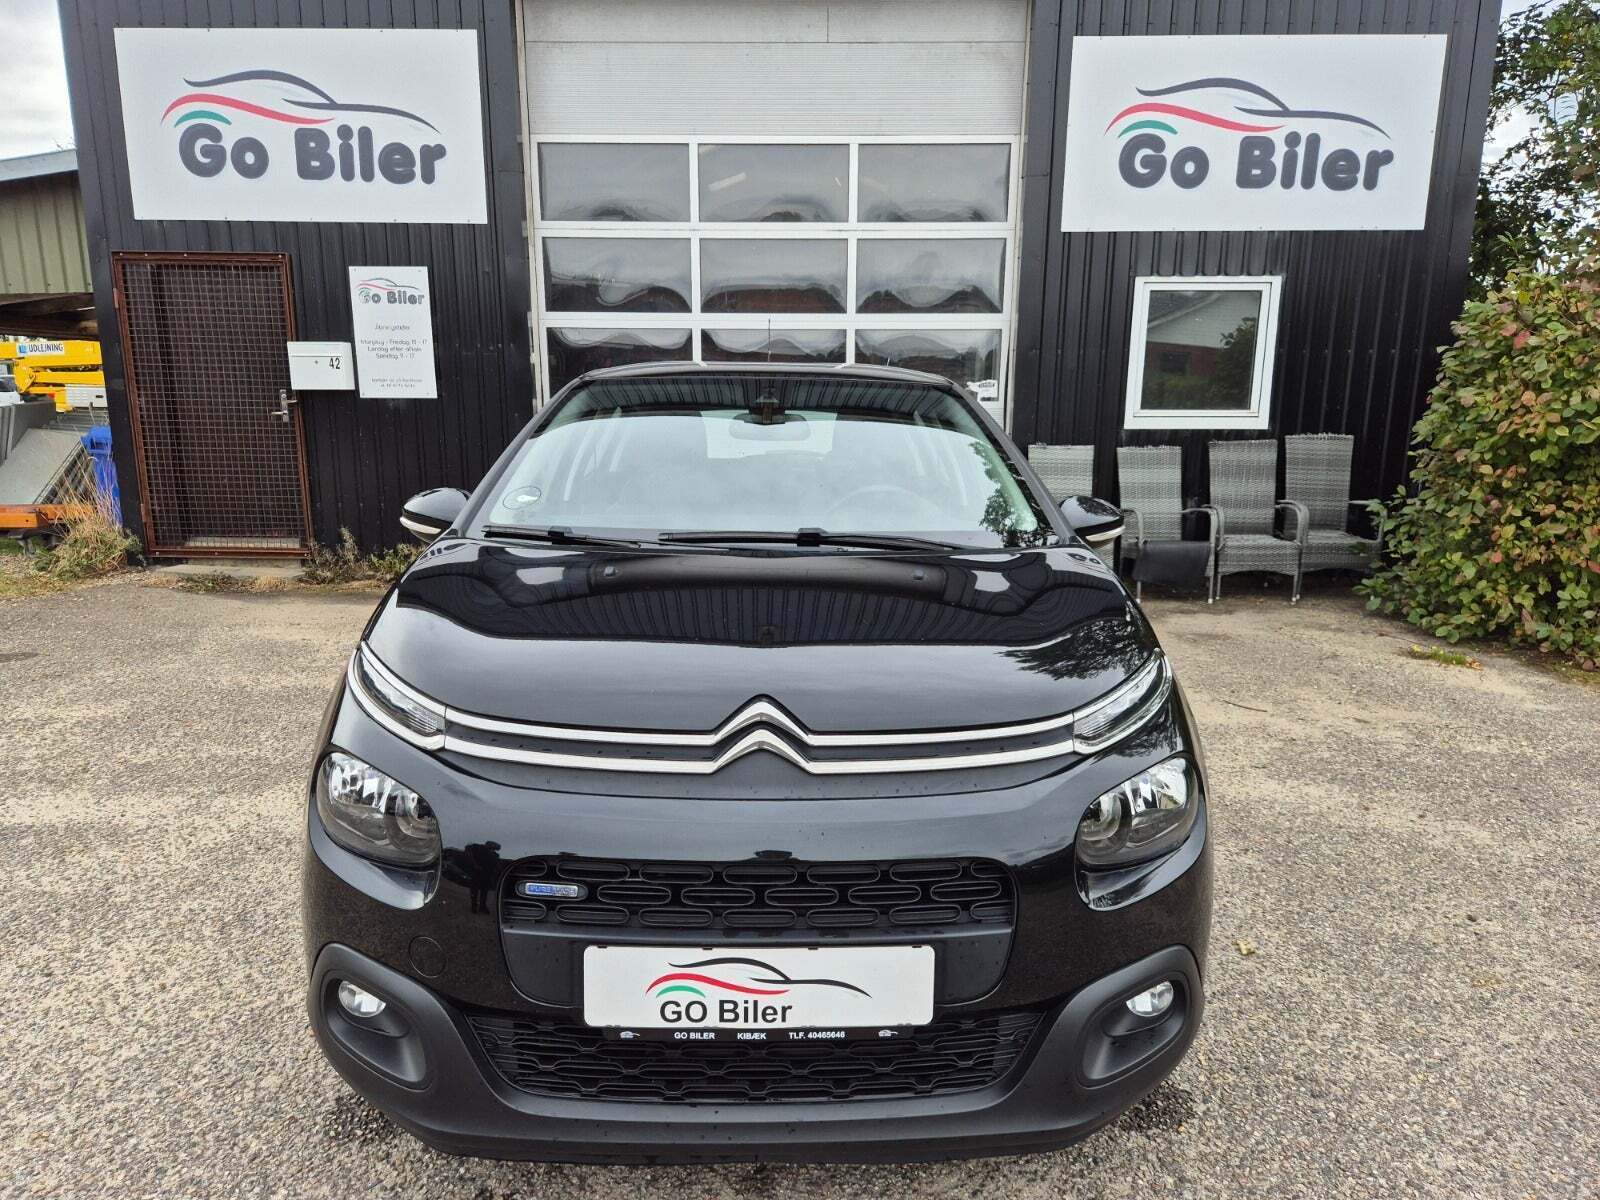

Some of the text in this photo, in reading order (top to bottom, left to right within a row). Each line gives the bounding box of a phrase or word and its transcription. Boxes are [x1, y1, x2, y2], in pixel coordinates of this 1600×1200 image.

[179, 123, 446, 184] Go Biler
[1119, 131, 1394, 191] Go Biler
[387, 290, 425, 304] Biler
[28, 343, 64, 352] UDLEJNING
[329, 357, 340, 370] 42
[660, 998, 792, 1024] GO Biler
[674, 1032, 688, 1040] GO
[689, 1032, 715, 1040] BILER
[737, 1032, 767, 1040] KIBÆK
[789, 1031, 806, 1039] TLF.
